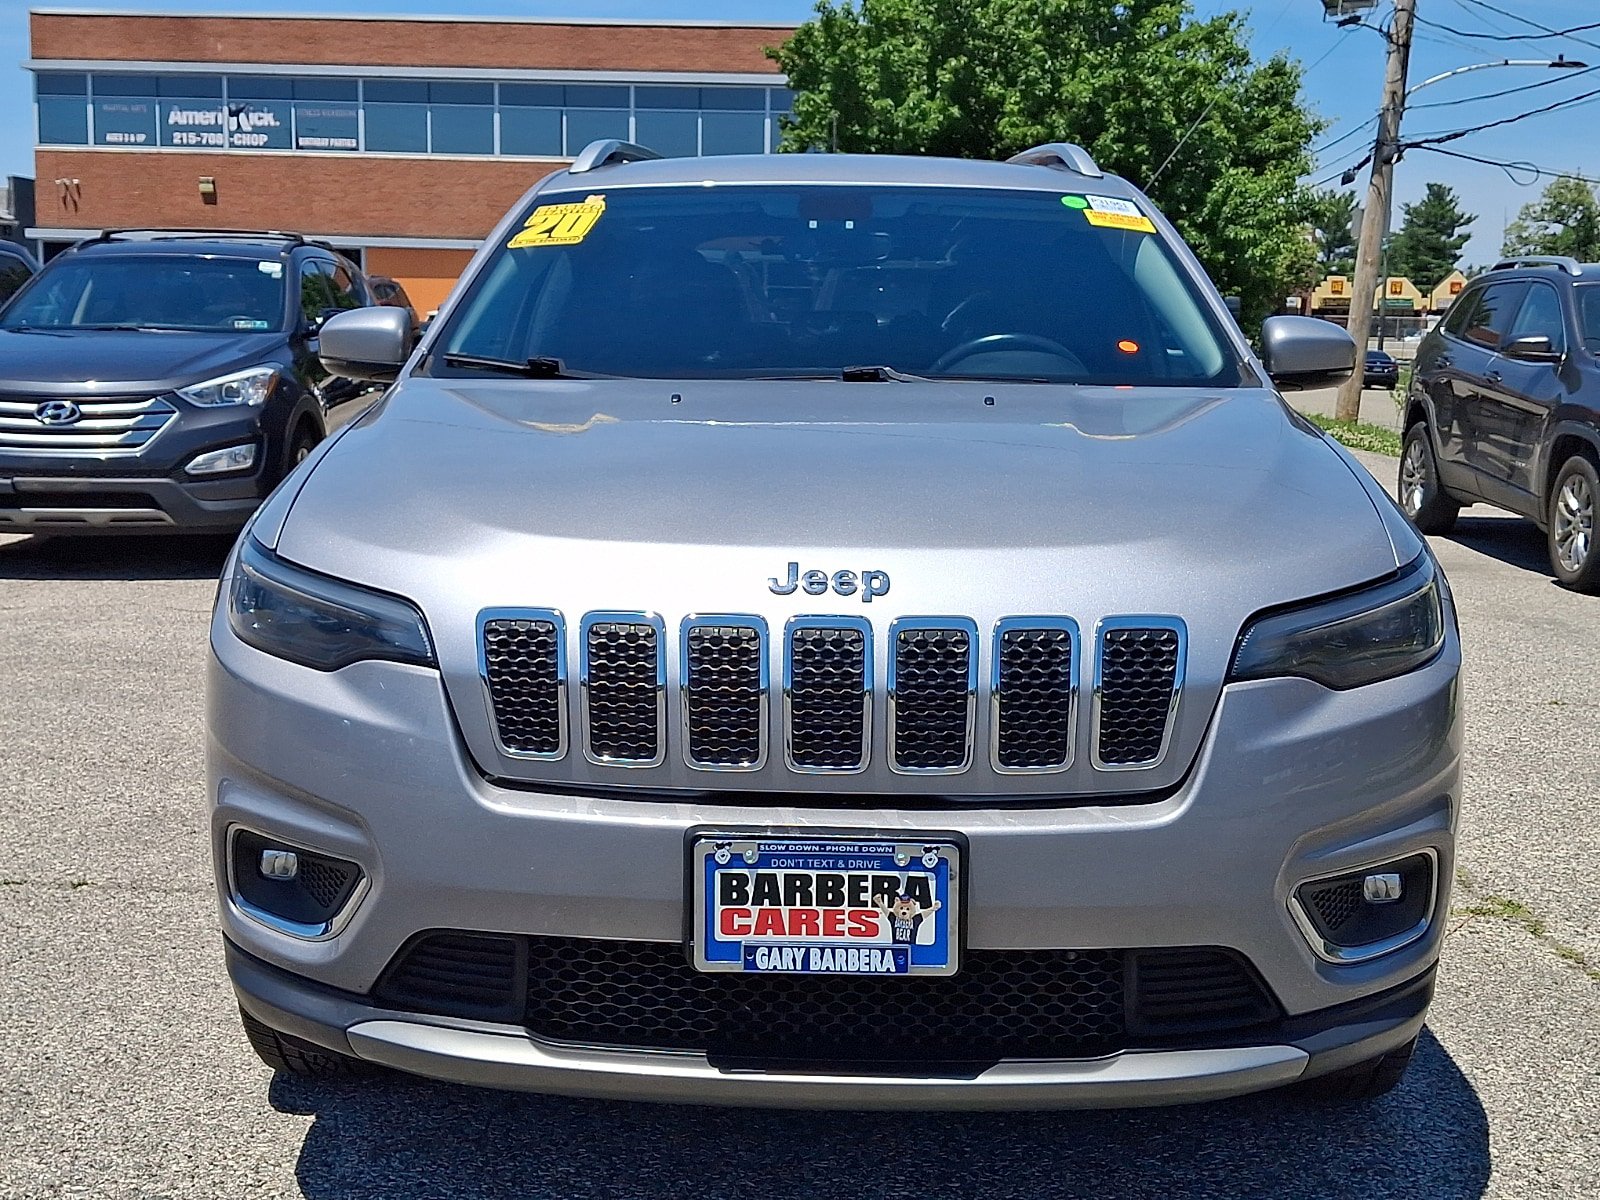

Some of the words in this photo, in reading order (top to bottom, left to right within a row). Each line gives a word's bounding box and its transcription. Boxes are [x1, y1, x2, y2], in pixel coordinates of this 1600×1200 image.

[516, 212, 599, 239] 20
[767, 562, 890, 603] Jeep
[771, 858, 804, 867] DON'T
[808, 859, 835, 868] TEXT
[837, 859, 845, 868] &
[848, 860, 880, 869] DRIVE
[719, 872, 934, 910] BARBERA
[720, 908, 880, 937] CARES
[895, 928, 911, 941] BEAR
[755, 947, 806, 970] GARY
[809, 947, 896, 972] BARBERA
